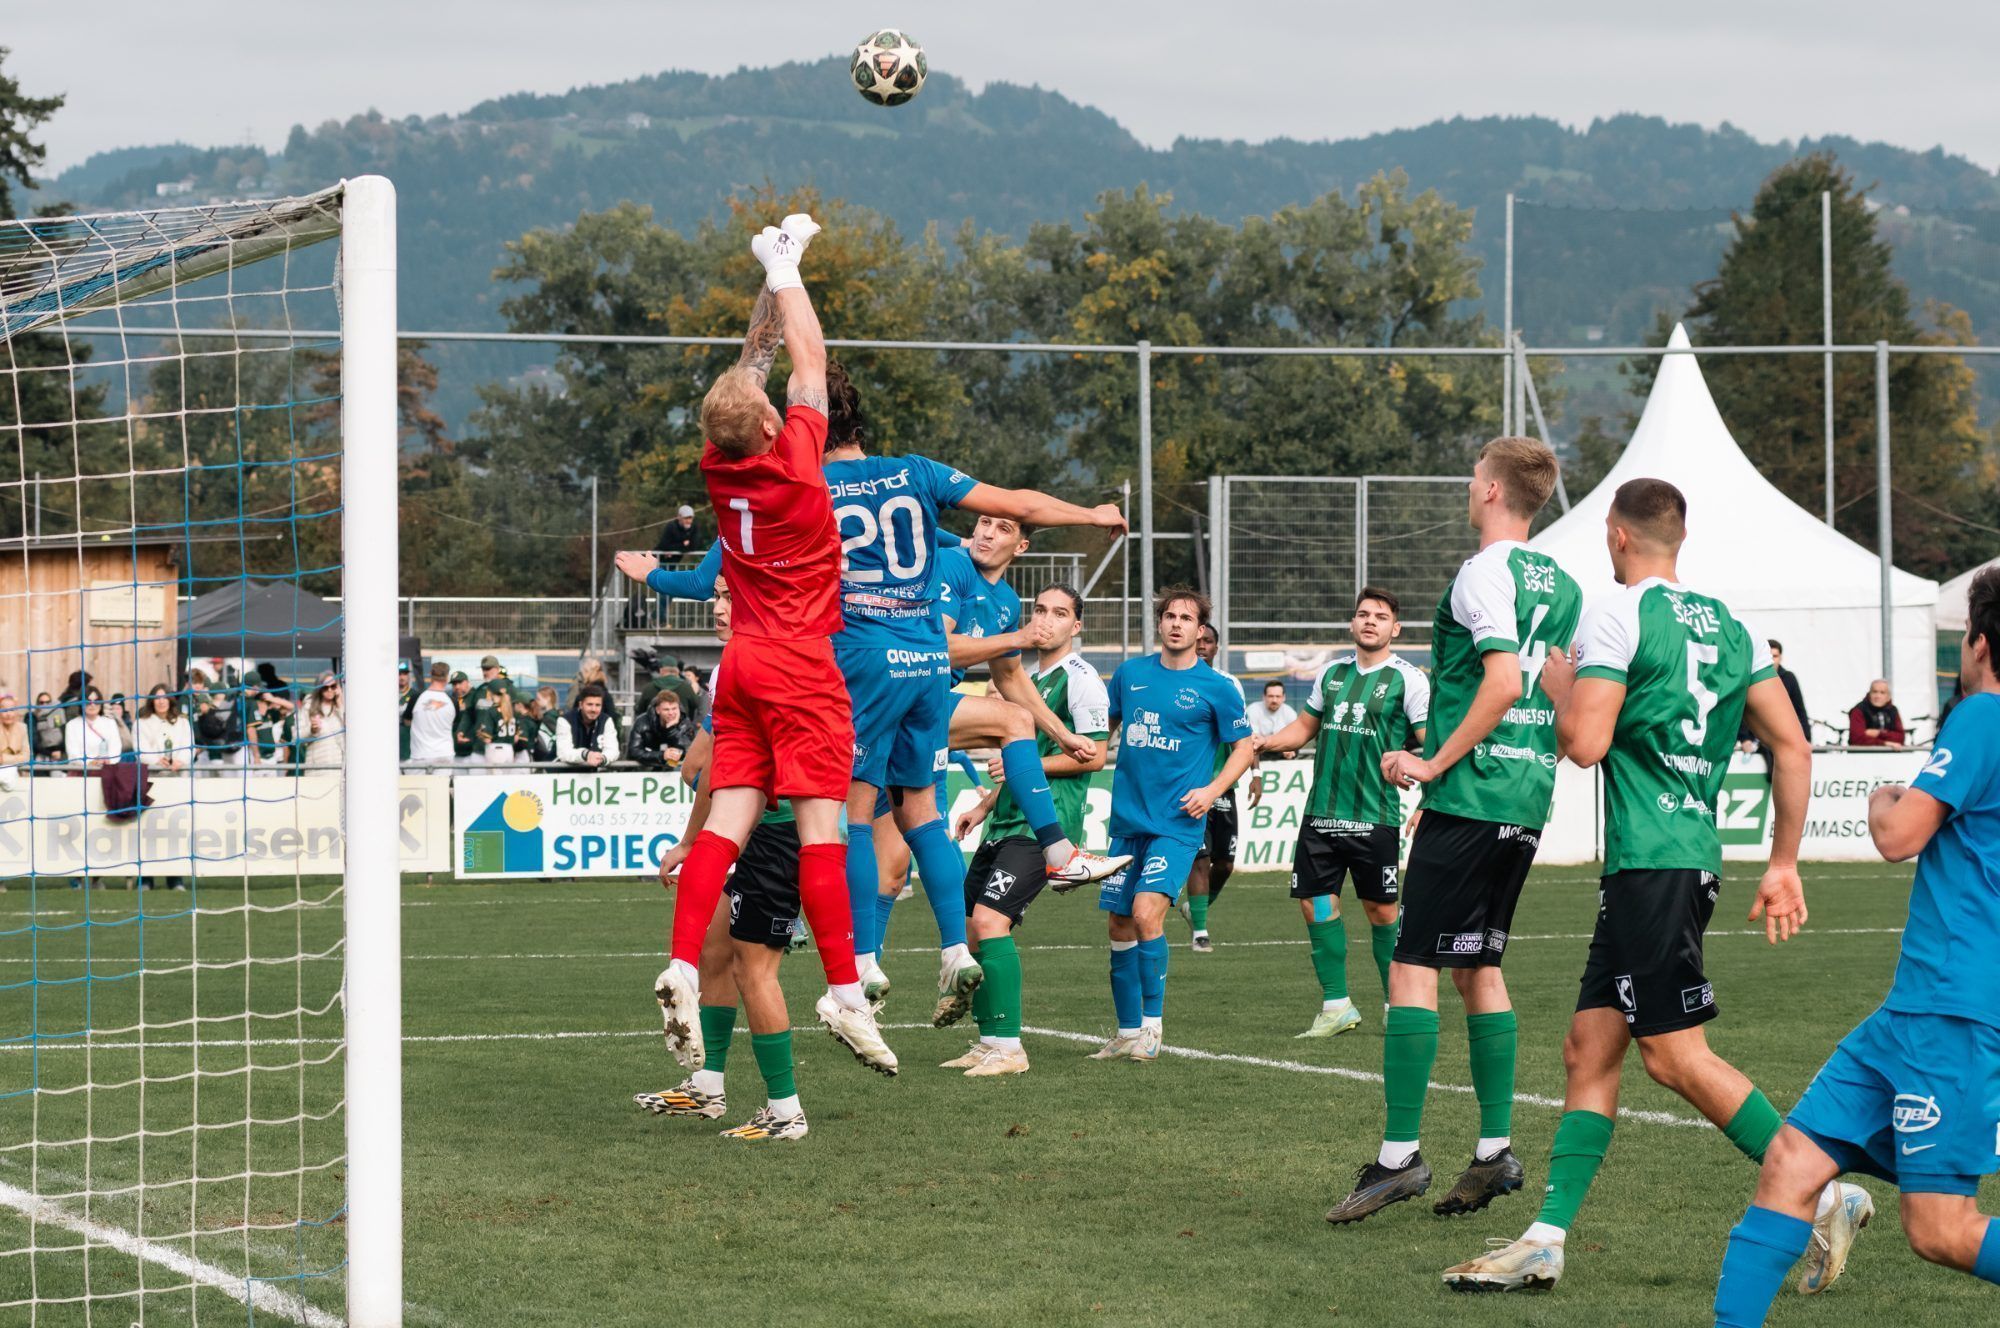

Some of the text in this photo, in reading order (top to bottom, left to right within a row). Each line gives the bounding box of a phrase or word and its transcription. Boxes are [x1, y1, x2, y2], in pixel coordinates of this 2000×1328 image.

[729, 497, 755, 555] 1
[833, 495, 927, 580] 20
[845, 603, 930, 618] Dornbirn-Schwefel
[1518, 603, 1550, 699] 4
[889, 669, 907, 678] Teich
[1681, 640, 1718, 746] 5
[552, 777, 695, 805] Holz-Pell
[1716, 788, 1765, 830] RZ
[46, 809, 341, 863] Raiffeisen
[570, 812, 604, 826] 0043
[655, 812, 672, 826] 22
[552, 833, 680, 871] SPIEG
[1292, 873, 1299, 889] 8
